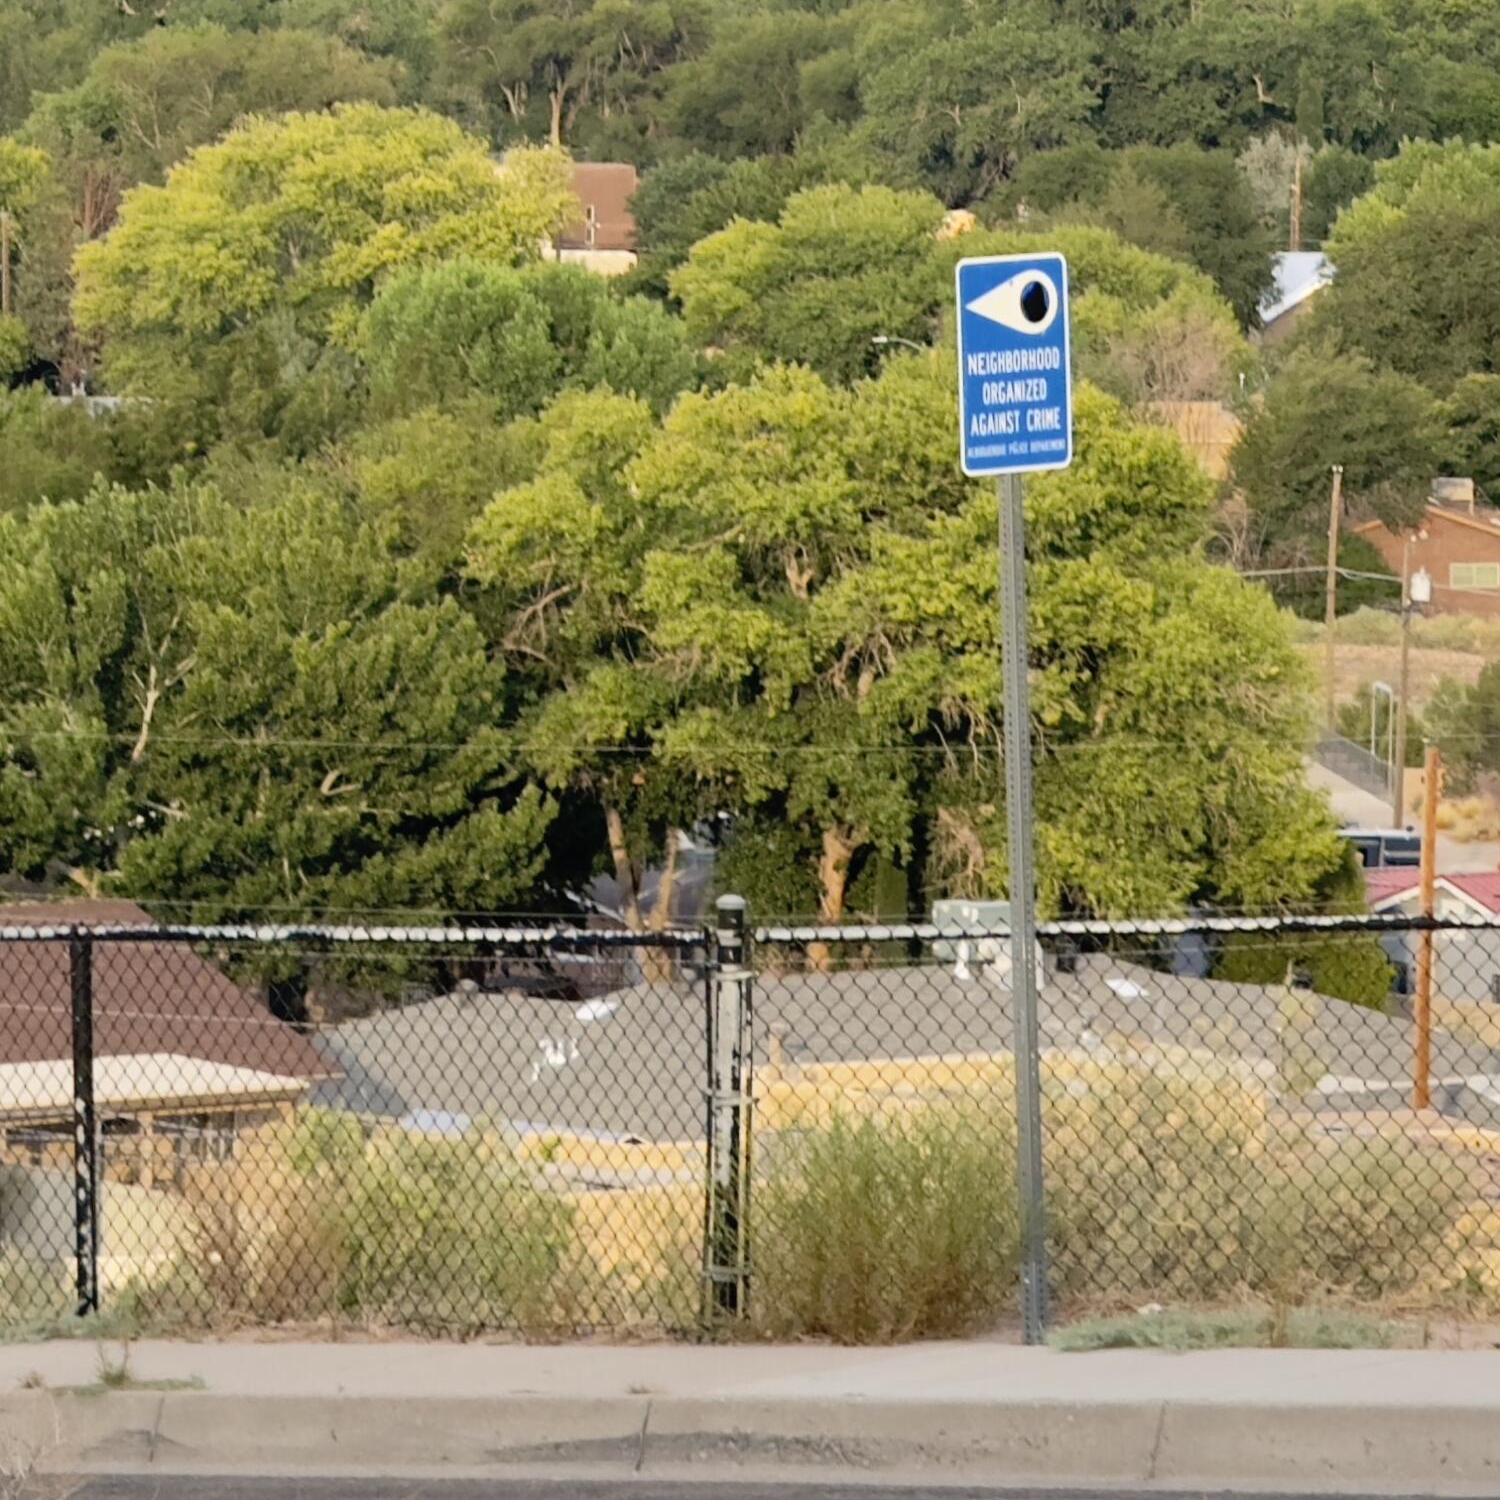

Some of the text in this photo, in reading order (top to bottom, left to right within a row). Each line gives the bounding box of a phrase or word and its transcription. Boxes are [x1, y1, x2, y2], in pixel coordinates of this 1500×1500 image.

[967, 346, 1060, 376] NEIGHBORHOOD
[982, 377, 1047, 406] ORGANIZED
[970, 406, 1061, 437] AGAINST CRIME
